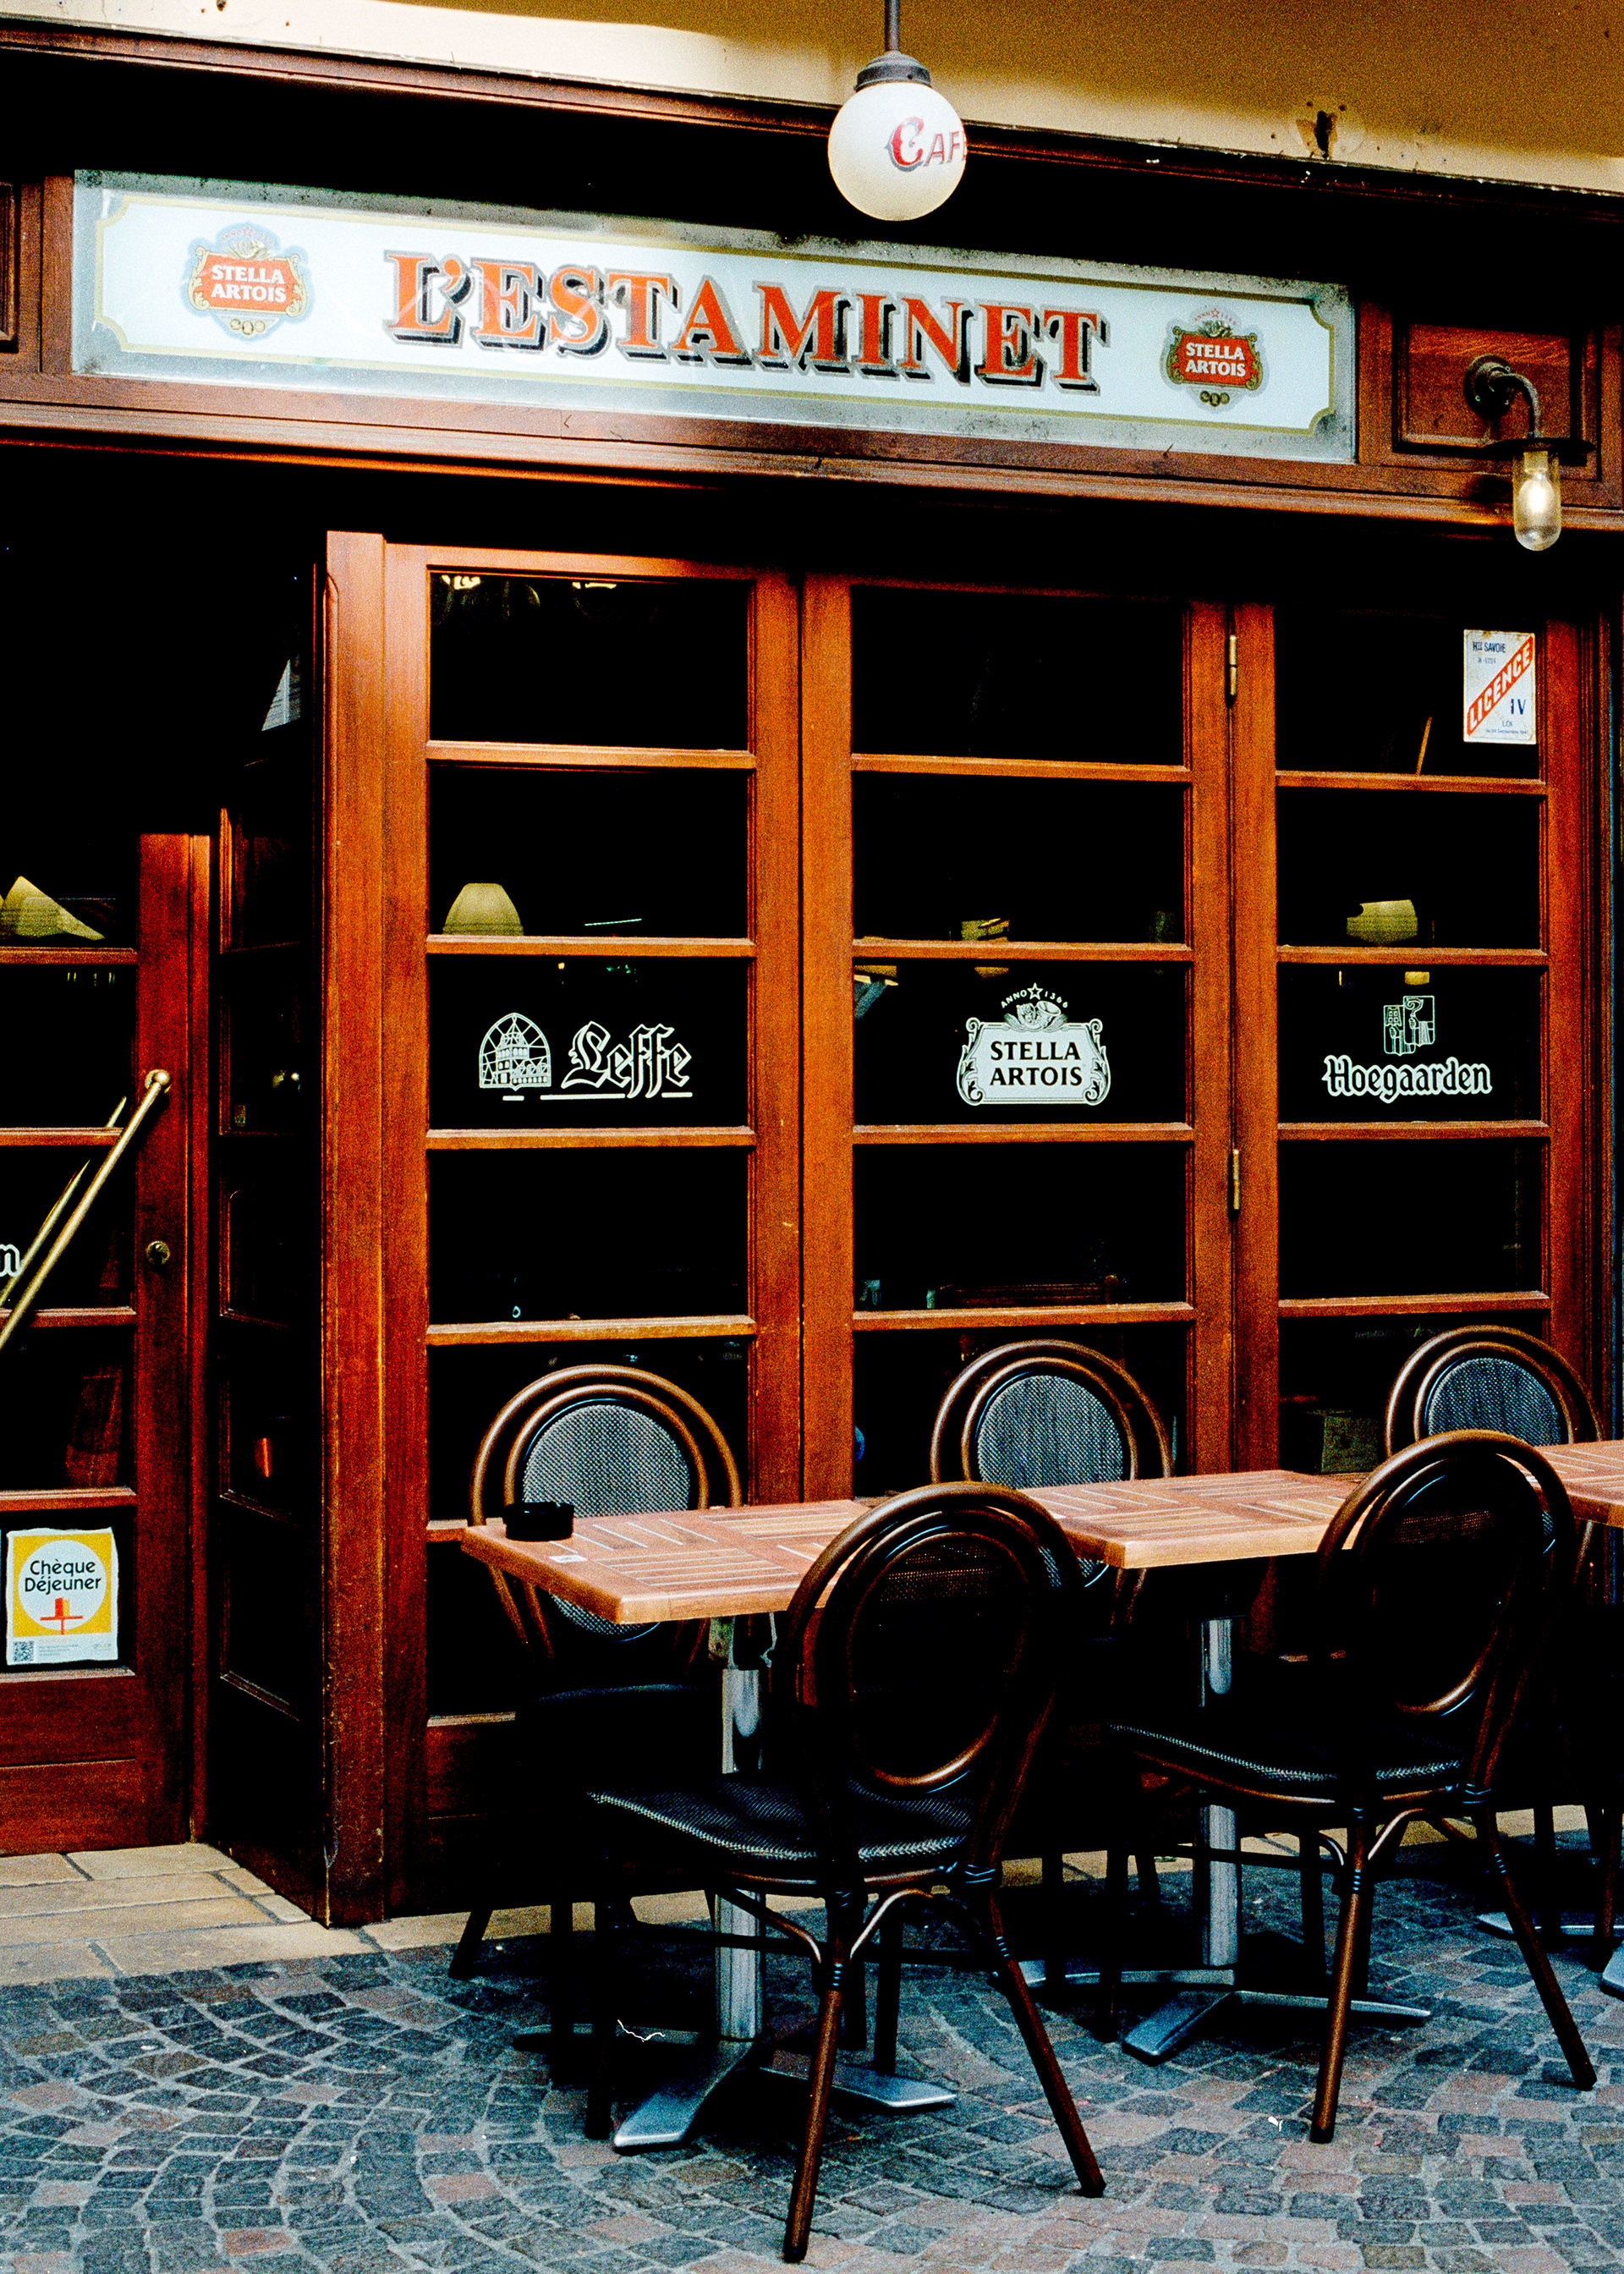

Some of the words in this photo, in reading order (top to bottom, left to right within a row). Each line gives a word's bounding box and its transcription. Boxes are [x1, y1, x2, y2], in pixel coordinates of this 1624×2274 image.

[211, 264, 286, 285] STELLA
[211, 284, 287, 303] ARTOIS
[383, 250, 1109, 396] L'ESTAMINET
[1186, 343, 1245, 360] STELLA
[1185, 360, 1247, 377] ARTOIS
[1484, 642, 1506, 653] SAVOIE
[1469, 642, 1530, 732] LICENCE
[1001, 989, 1028, 1008] ANNO
[1045, 990, 1068, 1008] 1366
[561, 1020, 692, 1099] Leffe
[990, 1041, 1081, 1061] STELLA
[990, 1066, 1083, 1086] ARTOIS
[1321, 1055, 1493, 1104] Hoegaarden
[30, 1558, 96, 1577] Chèque
[25, 1576, 102, 1596] Déjeuner
